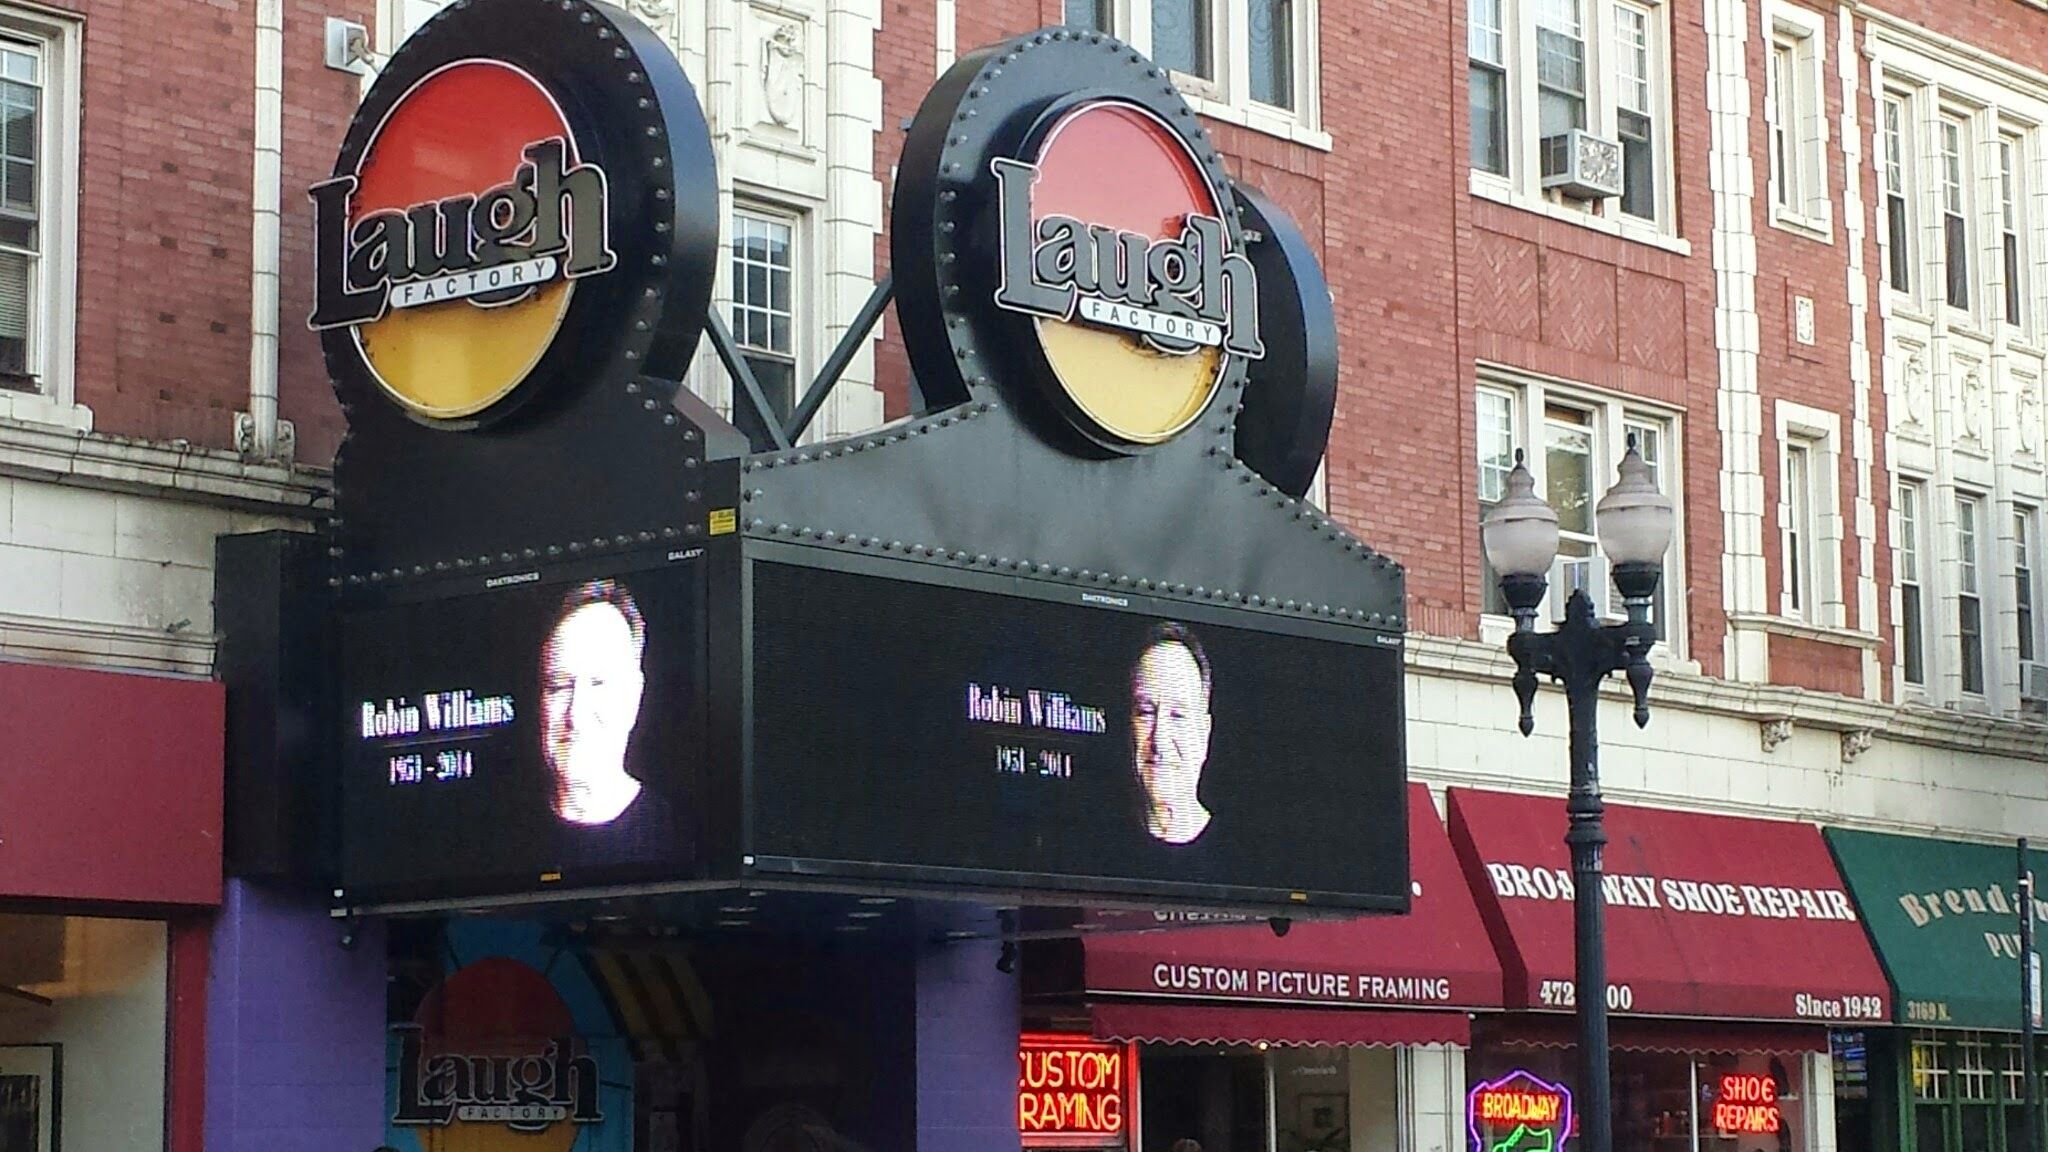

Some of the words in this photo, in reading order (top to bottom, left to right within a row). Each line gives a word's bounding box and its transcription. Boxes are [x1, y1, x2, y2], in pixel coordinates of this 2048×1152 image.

[308, 136, 617, 330] Laugh
[991, 157, 1265, 359] Laugh
[402, 260, 547, 303] FACTORY
[1092, 304, 1213, 341] FACTORY
[362, 698, 420, 738] Robin
[424, 690, 515, 729] Williams
[968, 682, 1022, 724] Robin
[1028, 689, 1106, 733] Williams
[1487, 863, 1660, 908] BROAWAY
[1661, 878, 1745, 915] SHOE
[1741, 885, 1856, 921] REPAIR
[1153, 963, 1248, 991] CUSTOM
[1256, 970, 1350, 997] PICTURE
[1358, 976, 1449, 999] FRAMING
[1796, 993, 1841, 1018] Since
[1843, 995, 1881, 1018] 1942
[1907, 1001, 1937, 1020] 3169
[391, 1022, 604, 1130] Laugh
[1723, 1076, 1776, 1100] SHOE
[466, 1106, 560, 1119] FACTORY
[1020, 1092, 1121, 1131] RAMING
[1483, 1092, 1560, 1121] BROADWAY
[1717, 1104, 1779, 1132] REPAIRS
